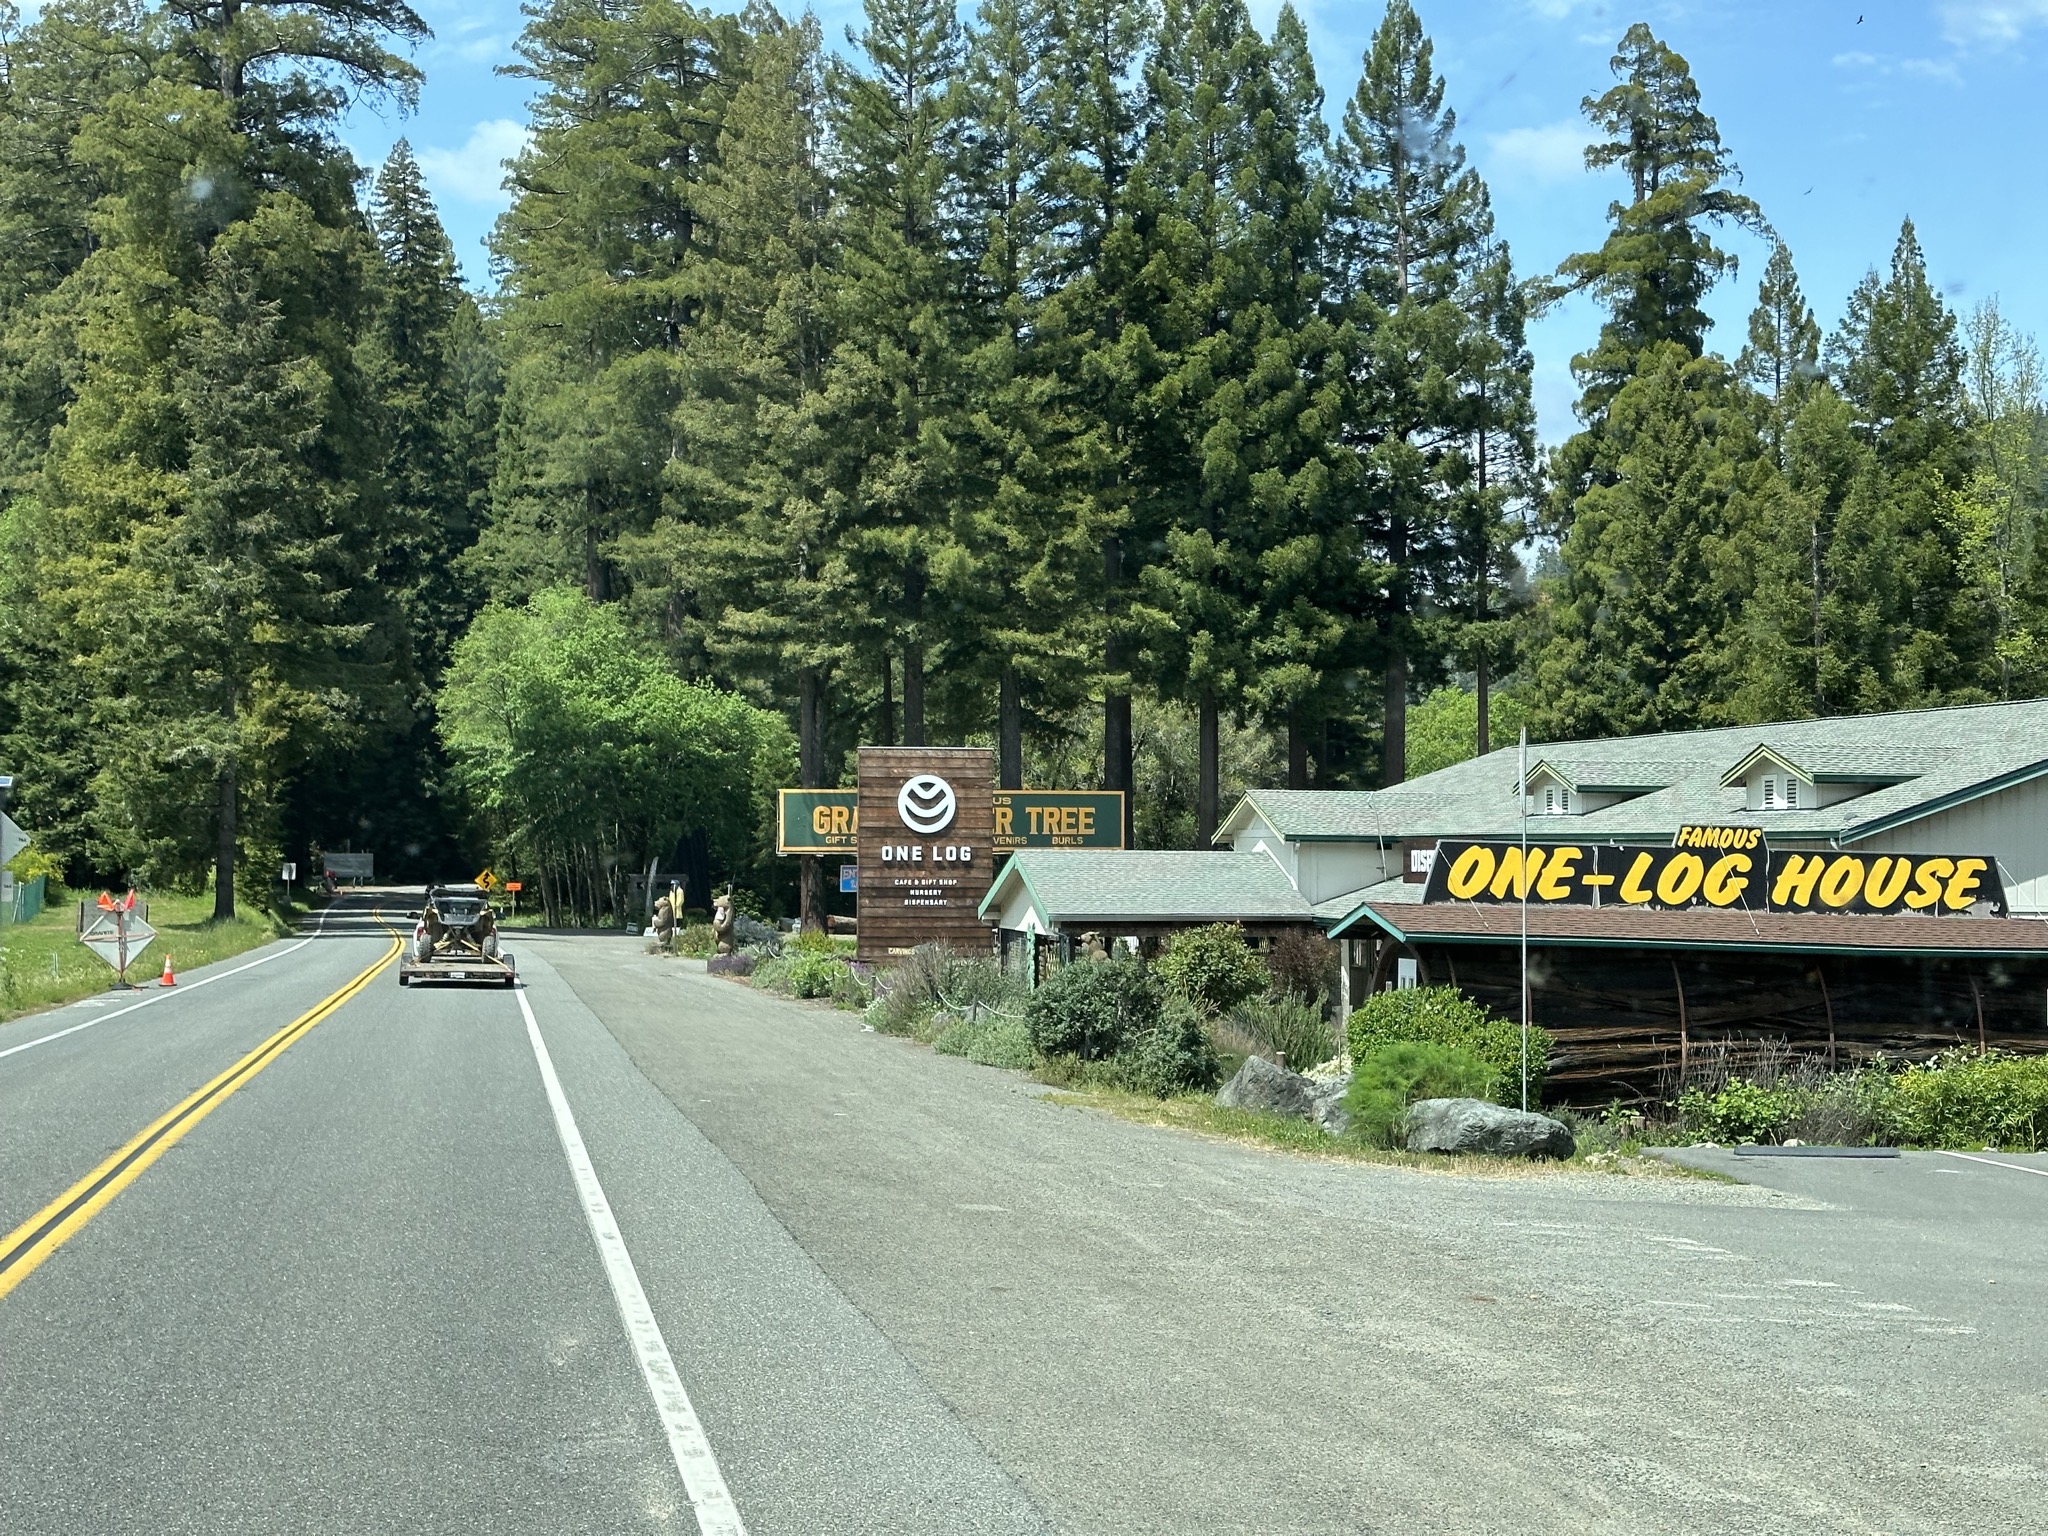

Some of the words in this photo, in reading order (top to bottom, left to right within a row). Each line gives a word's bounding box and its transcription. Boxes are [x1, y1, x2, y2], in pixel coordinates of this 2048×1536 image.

[992, 806, 1014, 835] R
[1025, 806, 1096, 835] TREE
[825, 836, 848, 844] GIFT
[1051, 836, 1084, 845] BURLS
[1677, 826, 1762, 850] FAMOUS
[881, 845, 923, 861] ONE
[932, 845, 972, 861] LOG
[1410, 849, 1436, 873] DISP
[1771, 854, 1988, 910] HOUSE
